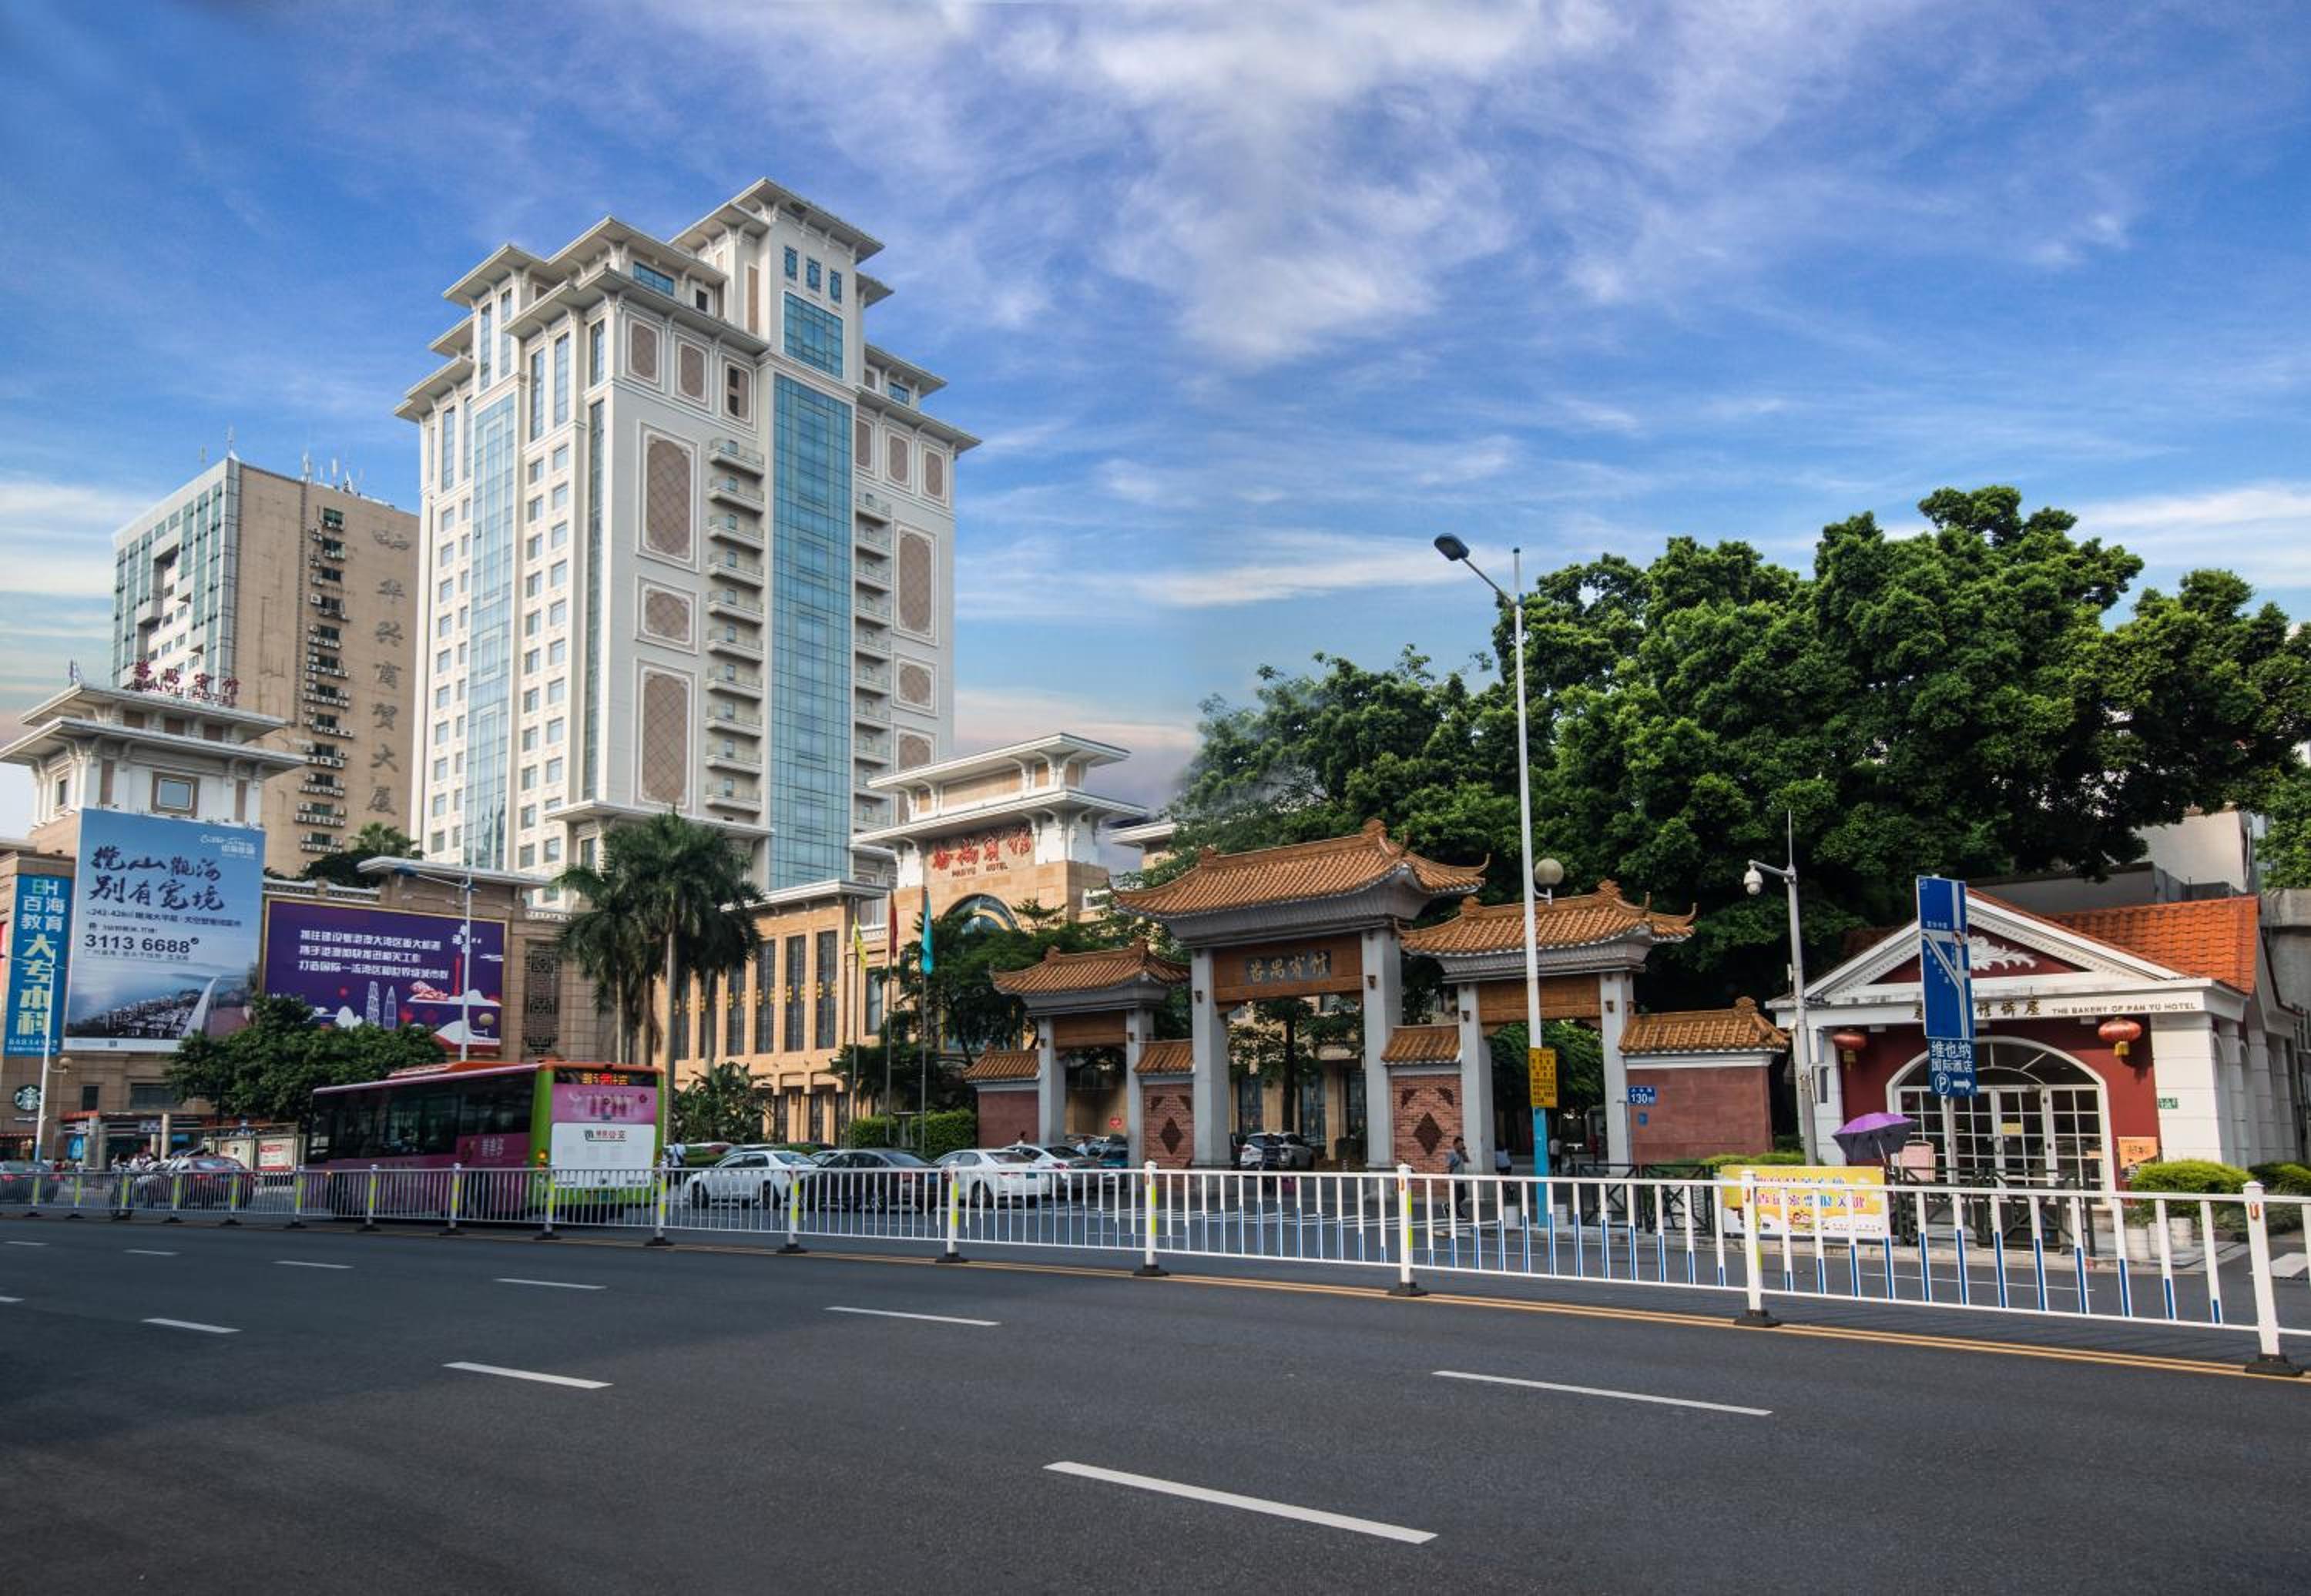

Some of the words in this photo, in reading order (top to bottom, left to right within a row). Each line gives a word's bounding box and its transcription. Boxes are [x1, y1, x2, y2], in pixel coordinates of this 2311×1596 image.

[84, 934, 135, 951] 3113
[141, 938, 190, 954] 6688
[1931, 1041, 1972, 1059] 维也纳
[1931, 1058, 1973, 1073] 国际酒店
